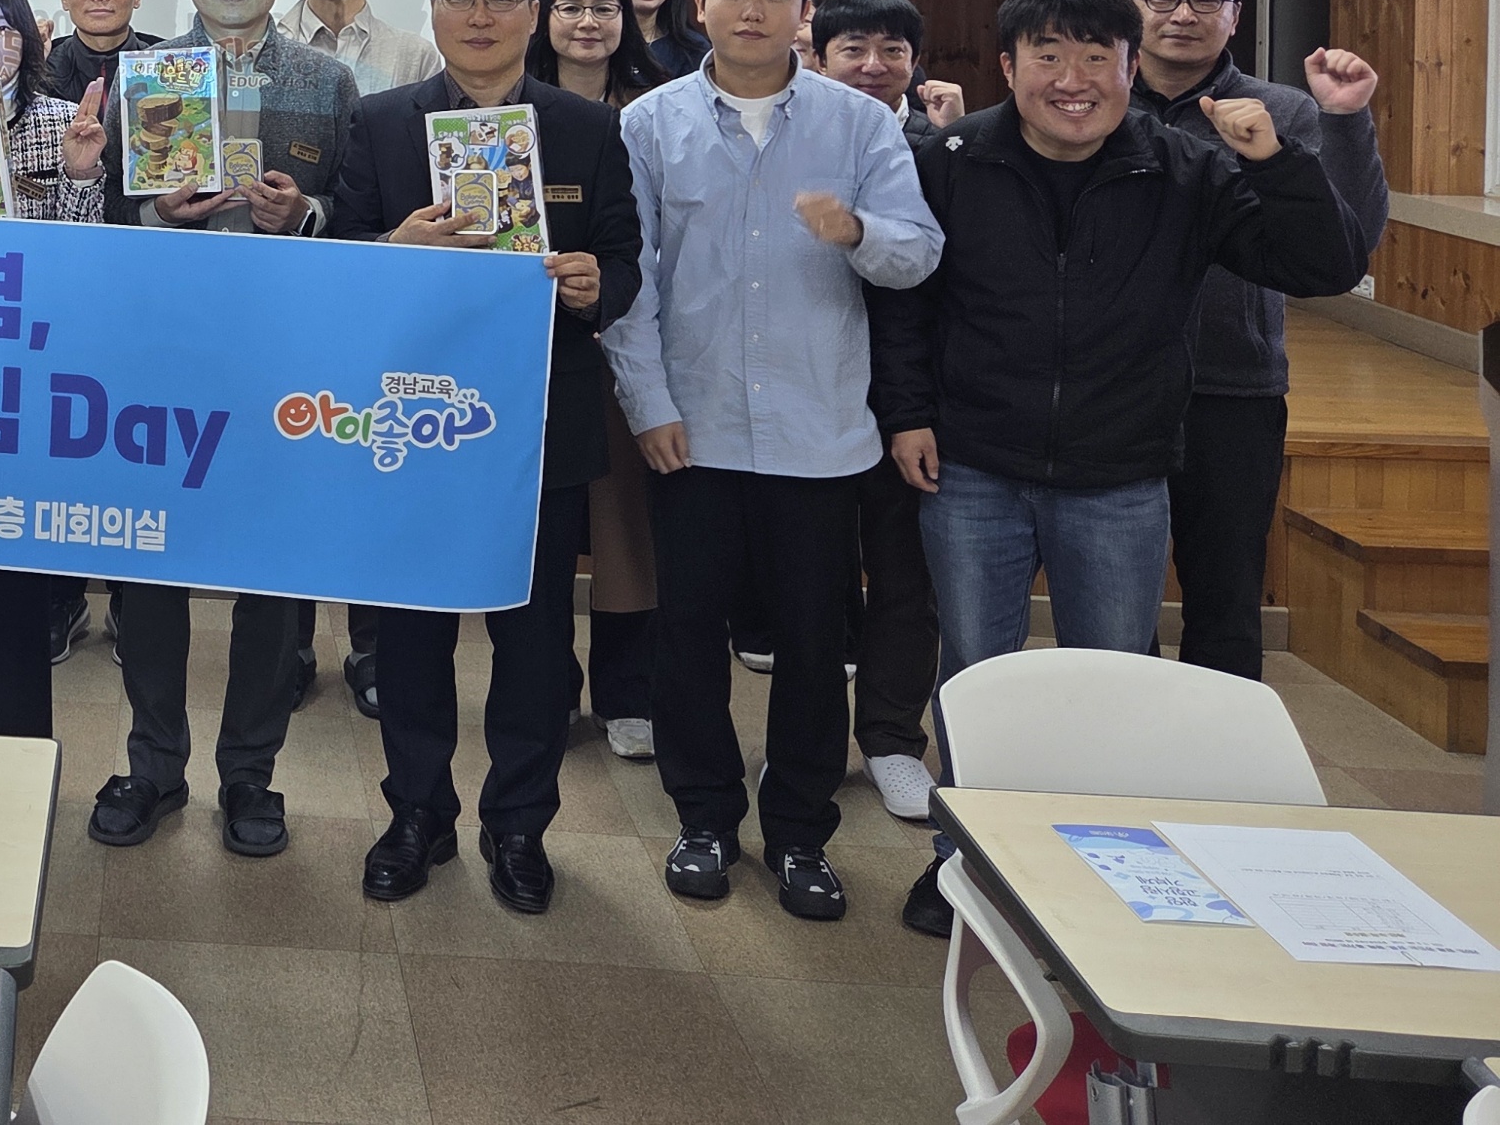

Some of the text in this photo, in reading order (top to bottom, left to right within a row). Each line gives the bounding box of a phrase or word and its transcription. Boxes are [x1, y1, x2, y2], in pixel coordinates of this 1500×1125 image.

[384, 375, 455, 400] 경남교육
[49, 373, 230, 489] Day
[277, 394, 493, 468] 아이좋아
[34, 503, 167, 553] 대회의실
